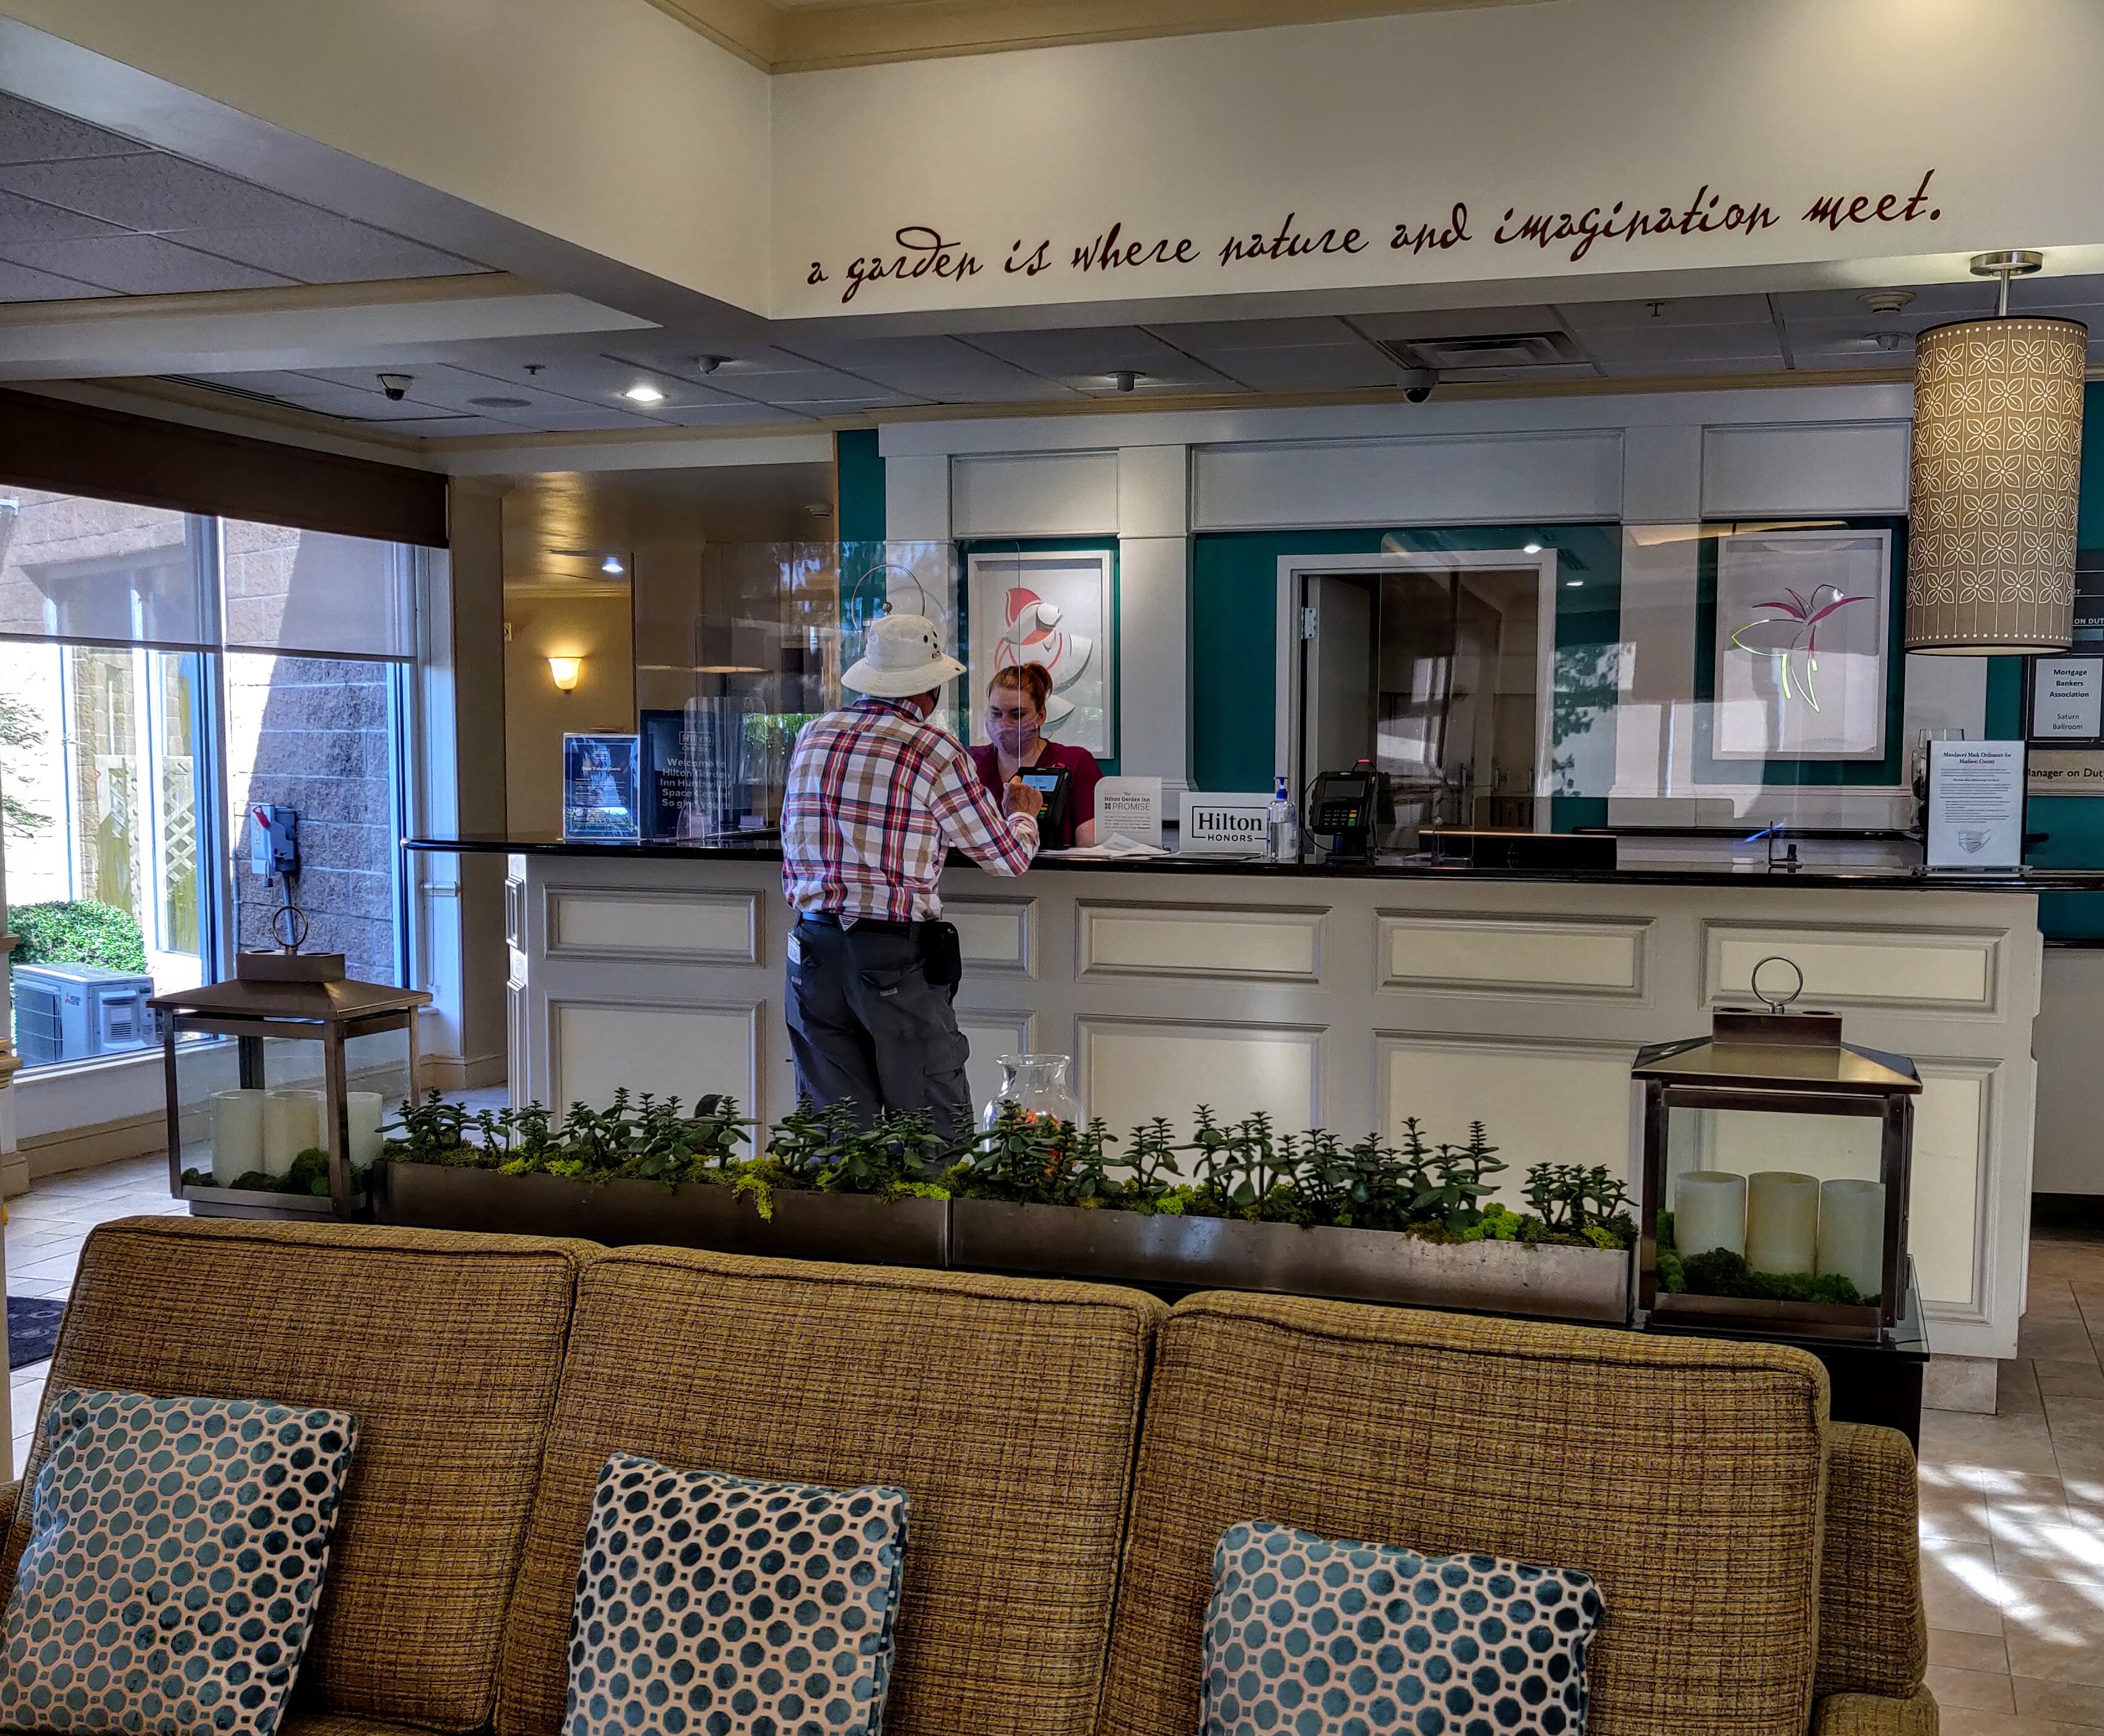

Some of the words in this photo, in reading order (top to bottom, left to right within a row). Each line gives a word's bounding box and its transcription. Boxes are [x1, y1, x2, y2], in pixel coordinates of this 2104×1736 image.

[807, 263, 828, 285] a
[842, 227, 984, 303] garden
[1005, 240, 1052, 276] is
[1071, 222, 1200, 272] where
[1218, 212, 1369, 267] nature
[1390, 202, 1472, 255] and
[1494, 184, 1780, 261] imagination
[1801, 169, 1940, 231] meet.
[662, 768, 692, 777] Hilton
[2028, 768, 2064, 779] anager
[2084, 768, 2104, 779] Dut
[660, 778, 675, 786] Inn
[662, 789, 692, 798] Space
[1112, 802, 1150, 810] PROMISE
[1198, 813, 1262, 831] Hilton
[1208, 834, 1253, 842] HONORS
